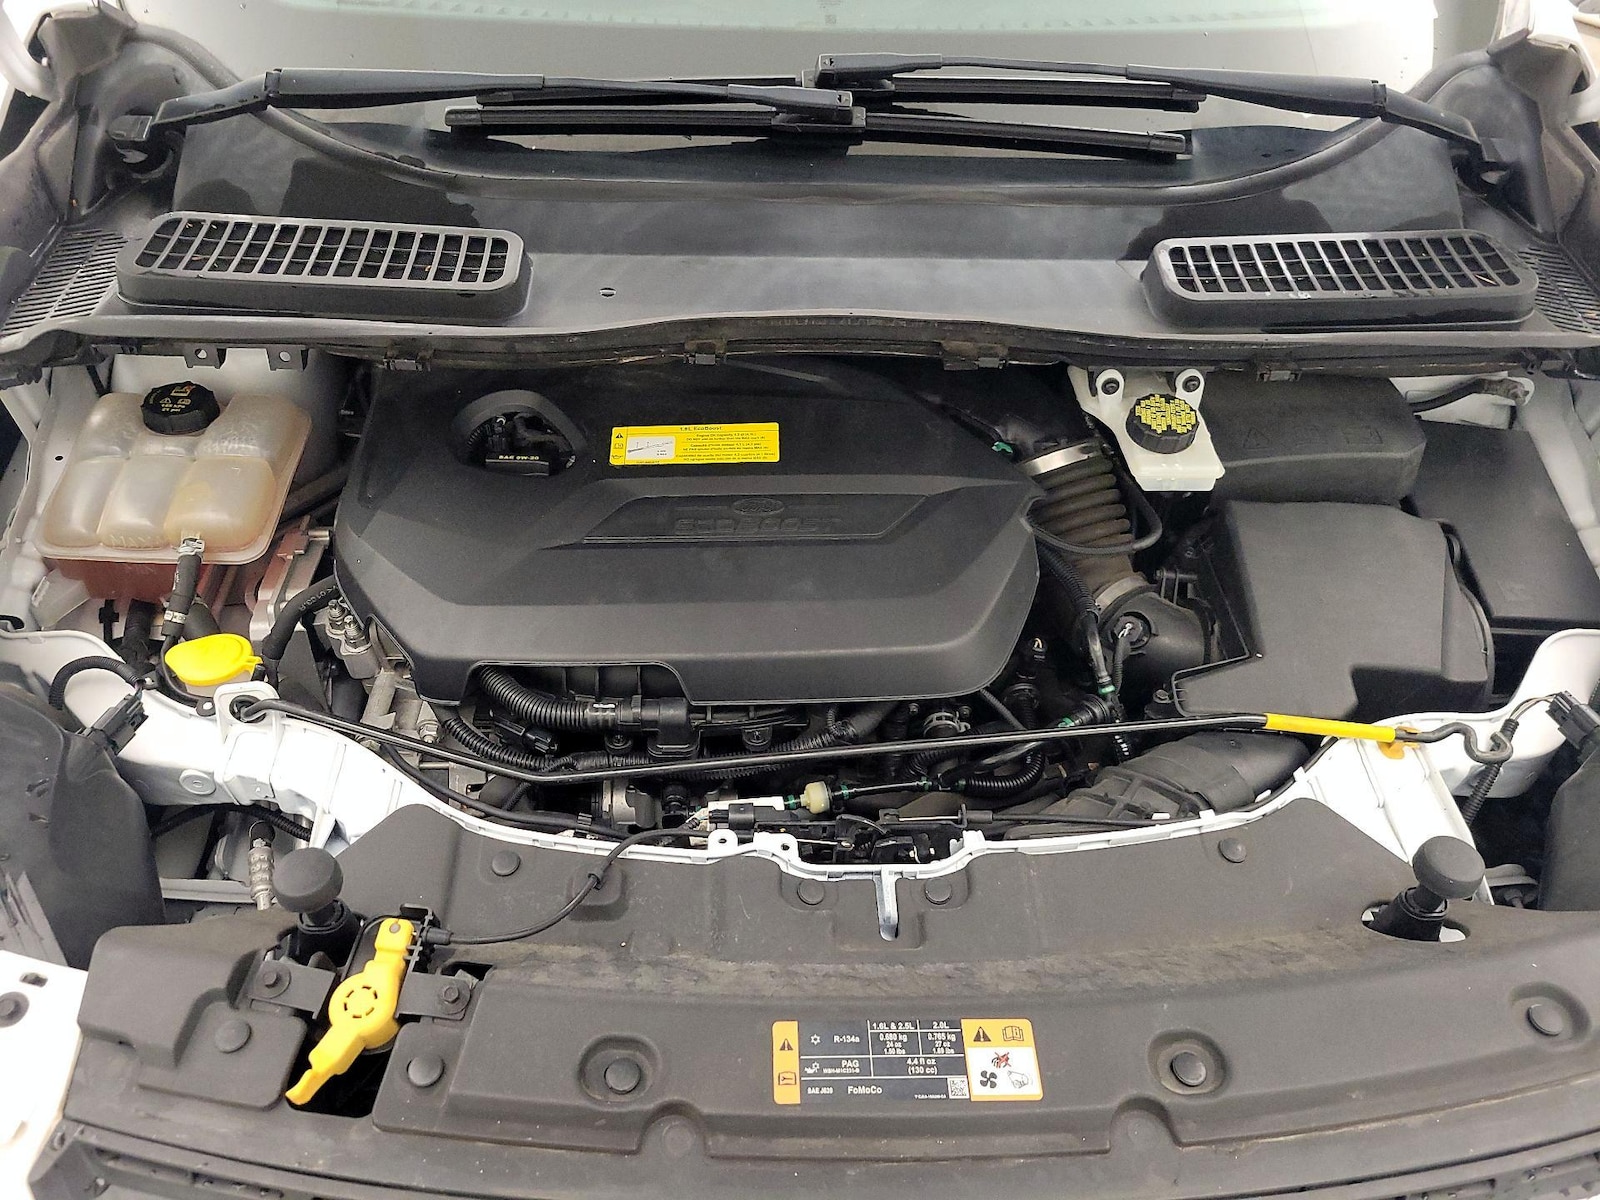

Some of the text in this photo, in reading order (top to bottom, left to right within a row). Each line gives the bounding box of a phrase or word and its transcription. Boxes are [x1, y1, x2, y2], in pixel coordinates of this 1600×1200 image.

[834, 1035, 860, 1043] R-134a
[898, 1033, 908, 1042] kg
[947, 1033, 956, 1042] kg
[908, 1066, 937, 1075] (130 cc)
[848, 1086, 882, 1094] FoMoCo
